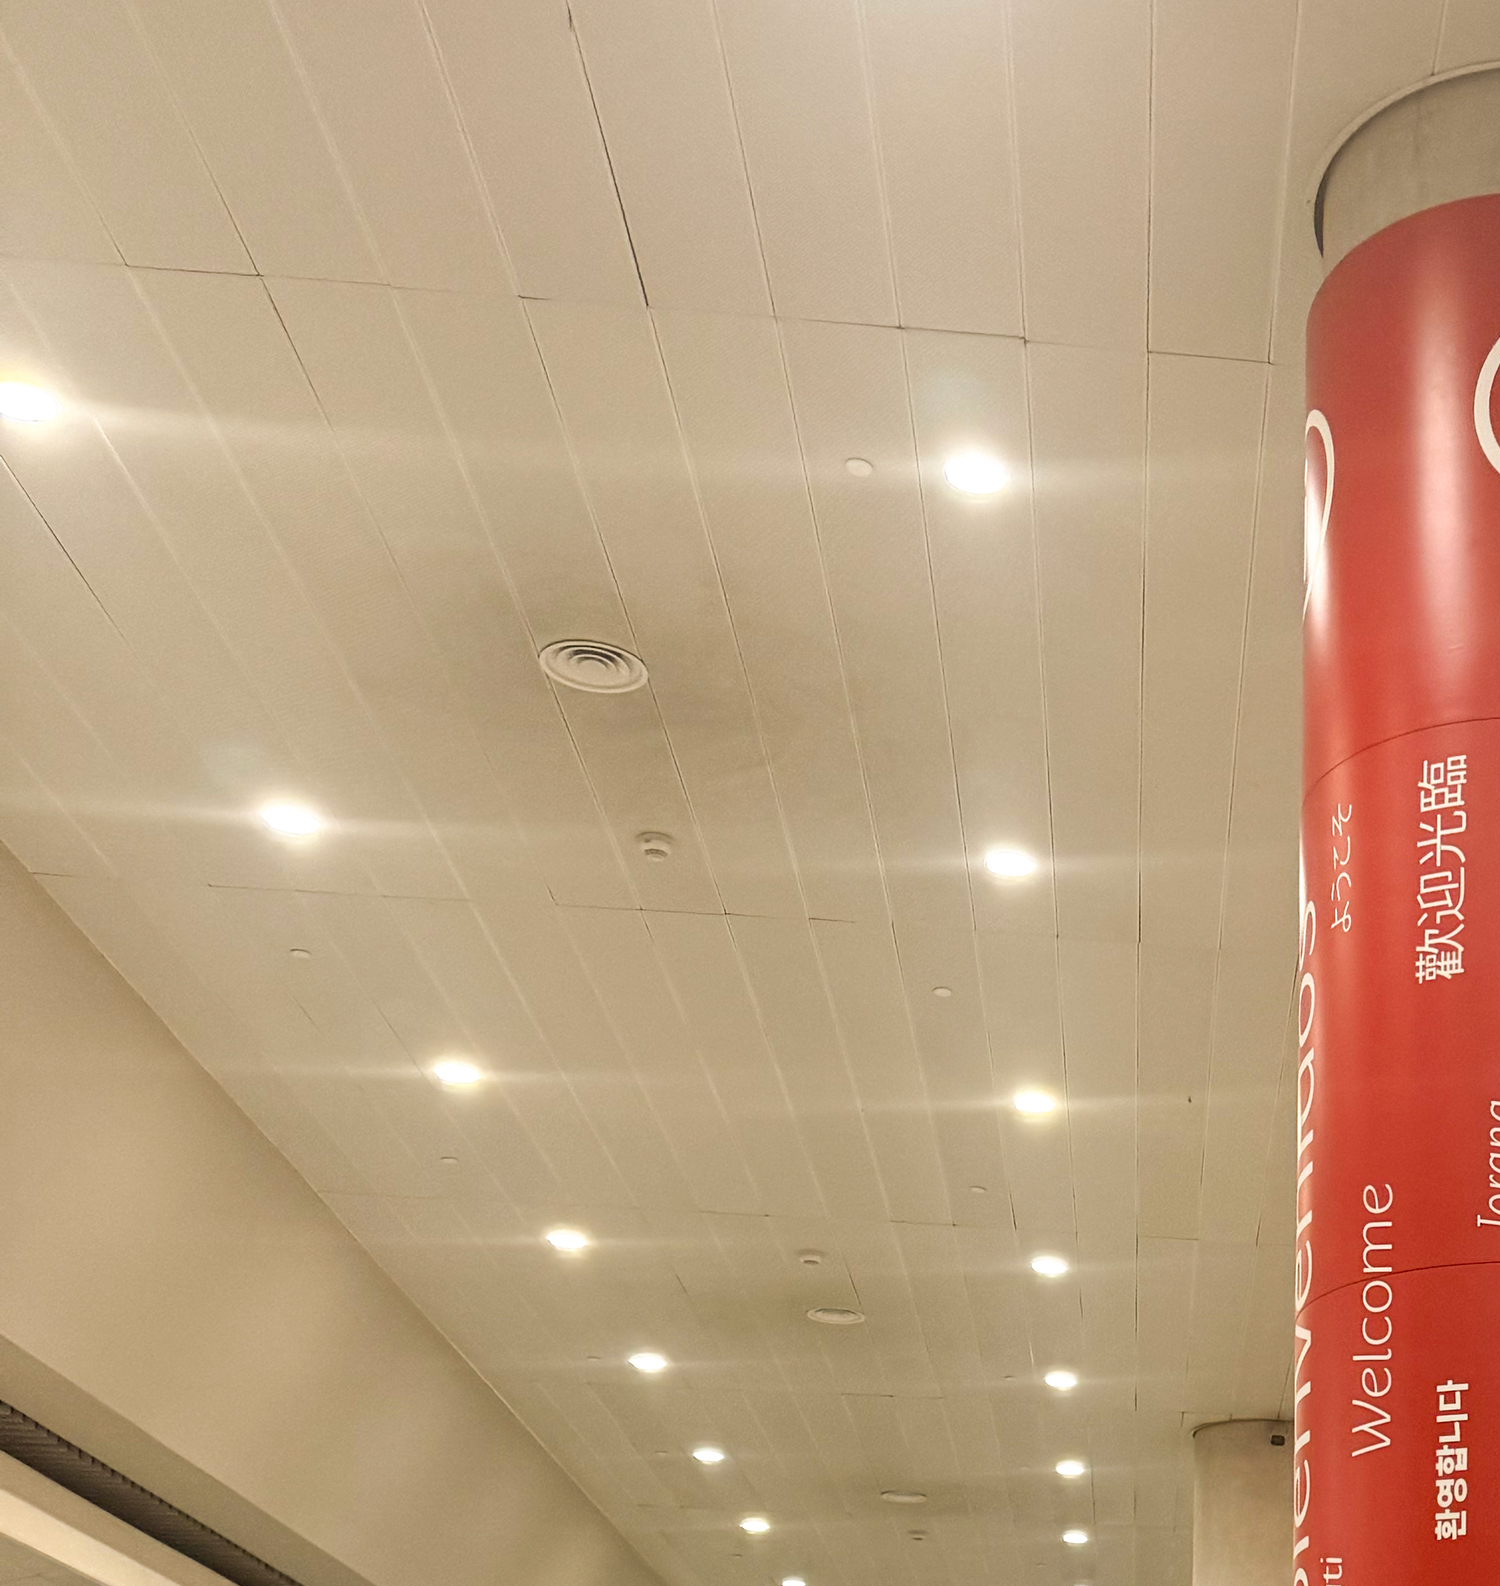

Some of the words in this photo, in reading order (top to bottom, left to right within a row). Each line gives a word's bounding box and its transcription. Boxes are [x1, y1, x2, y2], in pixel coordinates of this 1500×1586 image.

[1331, 802, 1353, 934] ようこそ
[1416, 754, 1468, 984] 歡迎光臨
[1352, 1182, 1394, 1458] Welcome
[1434, 1379, 1470, 1541] 환영합니다
